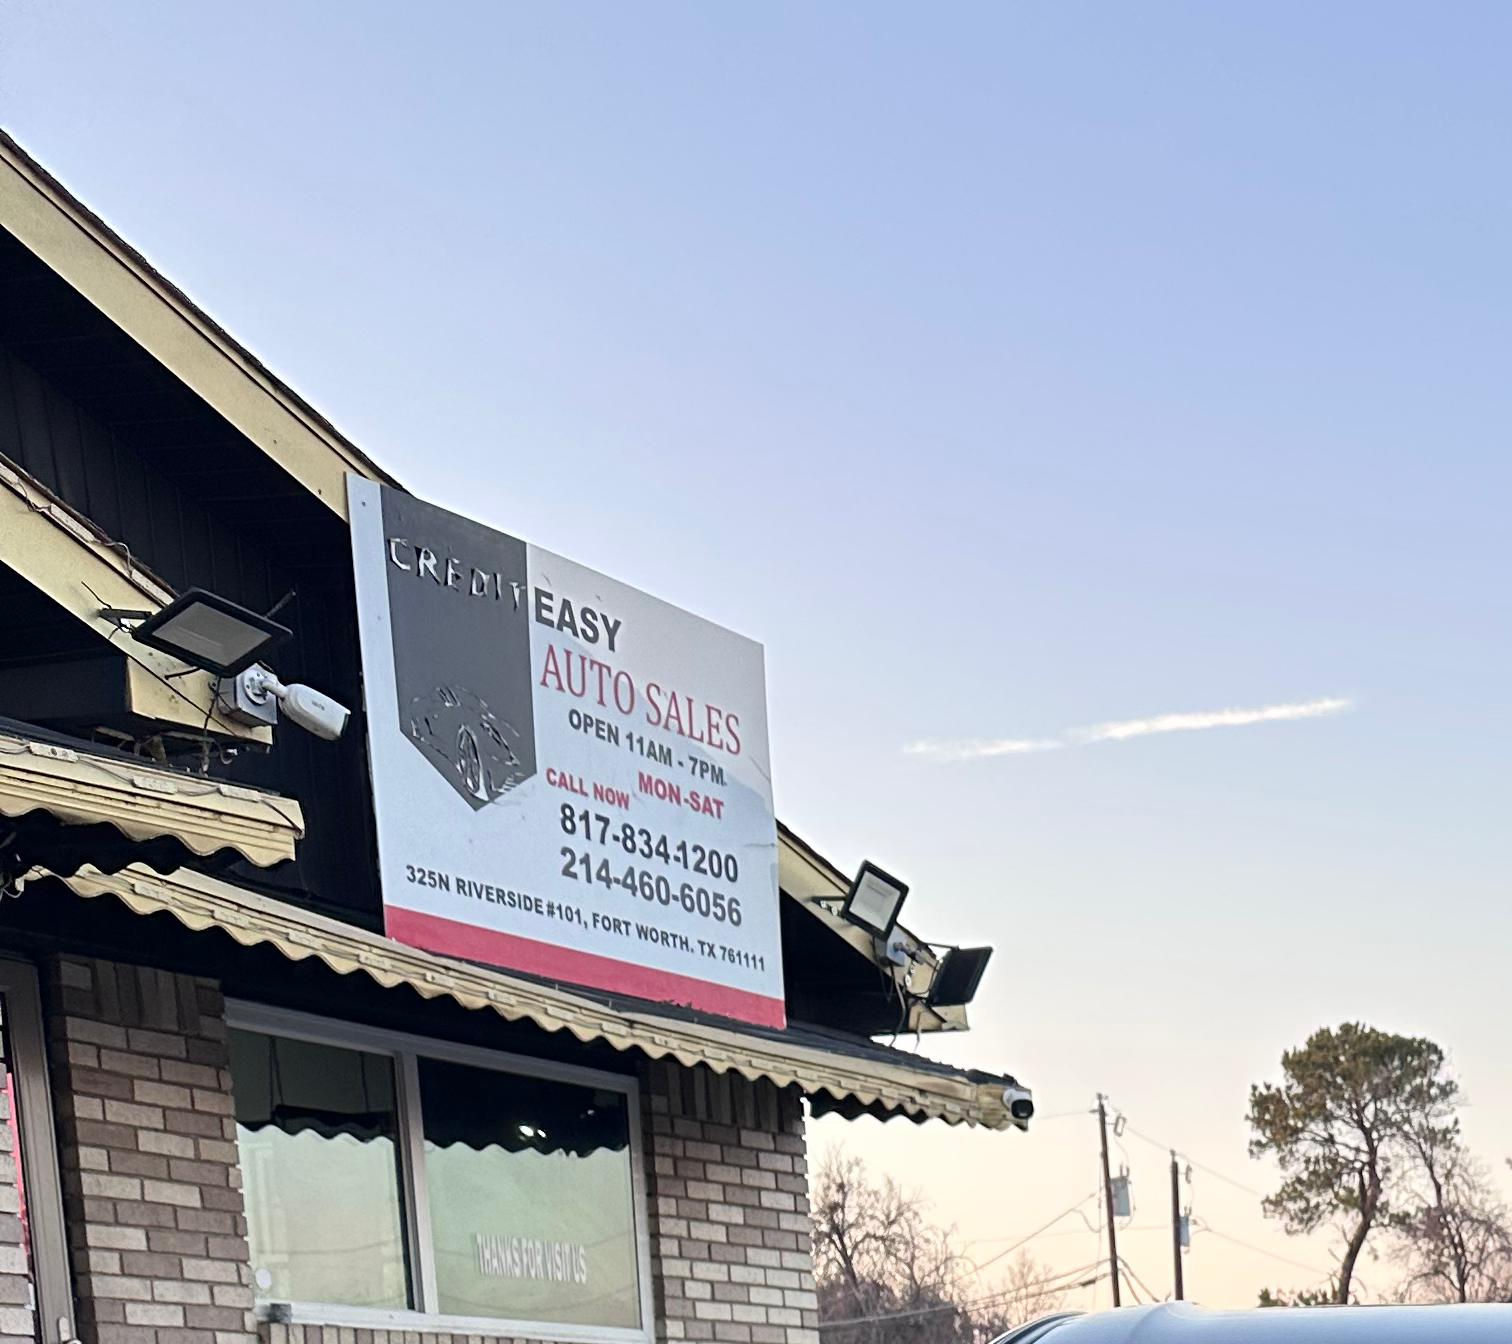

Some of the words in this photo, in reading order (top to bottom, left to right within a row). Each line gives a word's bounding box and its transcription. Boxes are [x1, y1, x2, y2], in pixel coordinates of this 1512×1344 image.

[388, 537, 526, 611] CREDIT
[535, 587, 621, 652] EASY
[540, 644, 635, 715] AUTO
[646, 683, 741, 755] SALES
[569, 709, 619, 746] OPEN
[626, 731, 672, 767] 11AM
[689, 756, 726, 786] 7PM
[546, 767, 588, 797] CALL
[593, 782, 630, 810] NOW
[638, 771, 724, 819] MON-SAT
[560, 803, 738, 883] 817-834-1200
[406, 864, 450, 892] 325N
[456, 877, 544, 916] RIVERSIDE
[546, 900, 588, 929] #101,
[592, 912, 631, 937] FORT
[697, 940, 716, 959] TX
[719, 946, 765, 971] 761111
[561, 847, 742, 926] 214-460-6056
[476, 1232, 520, 1277] THANKS
[521, 1238, 544, 1279] FOR
[544, 1240, 570, 1282] VISIT
[571, 1243, 586, 1284] US
